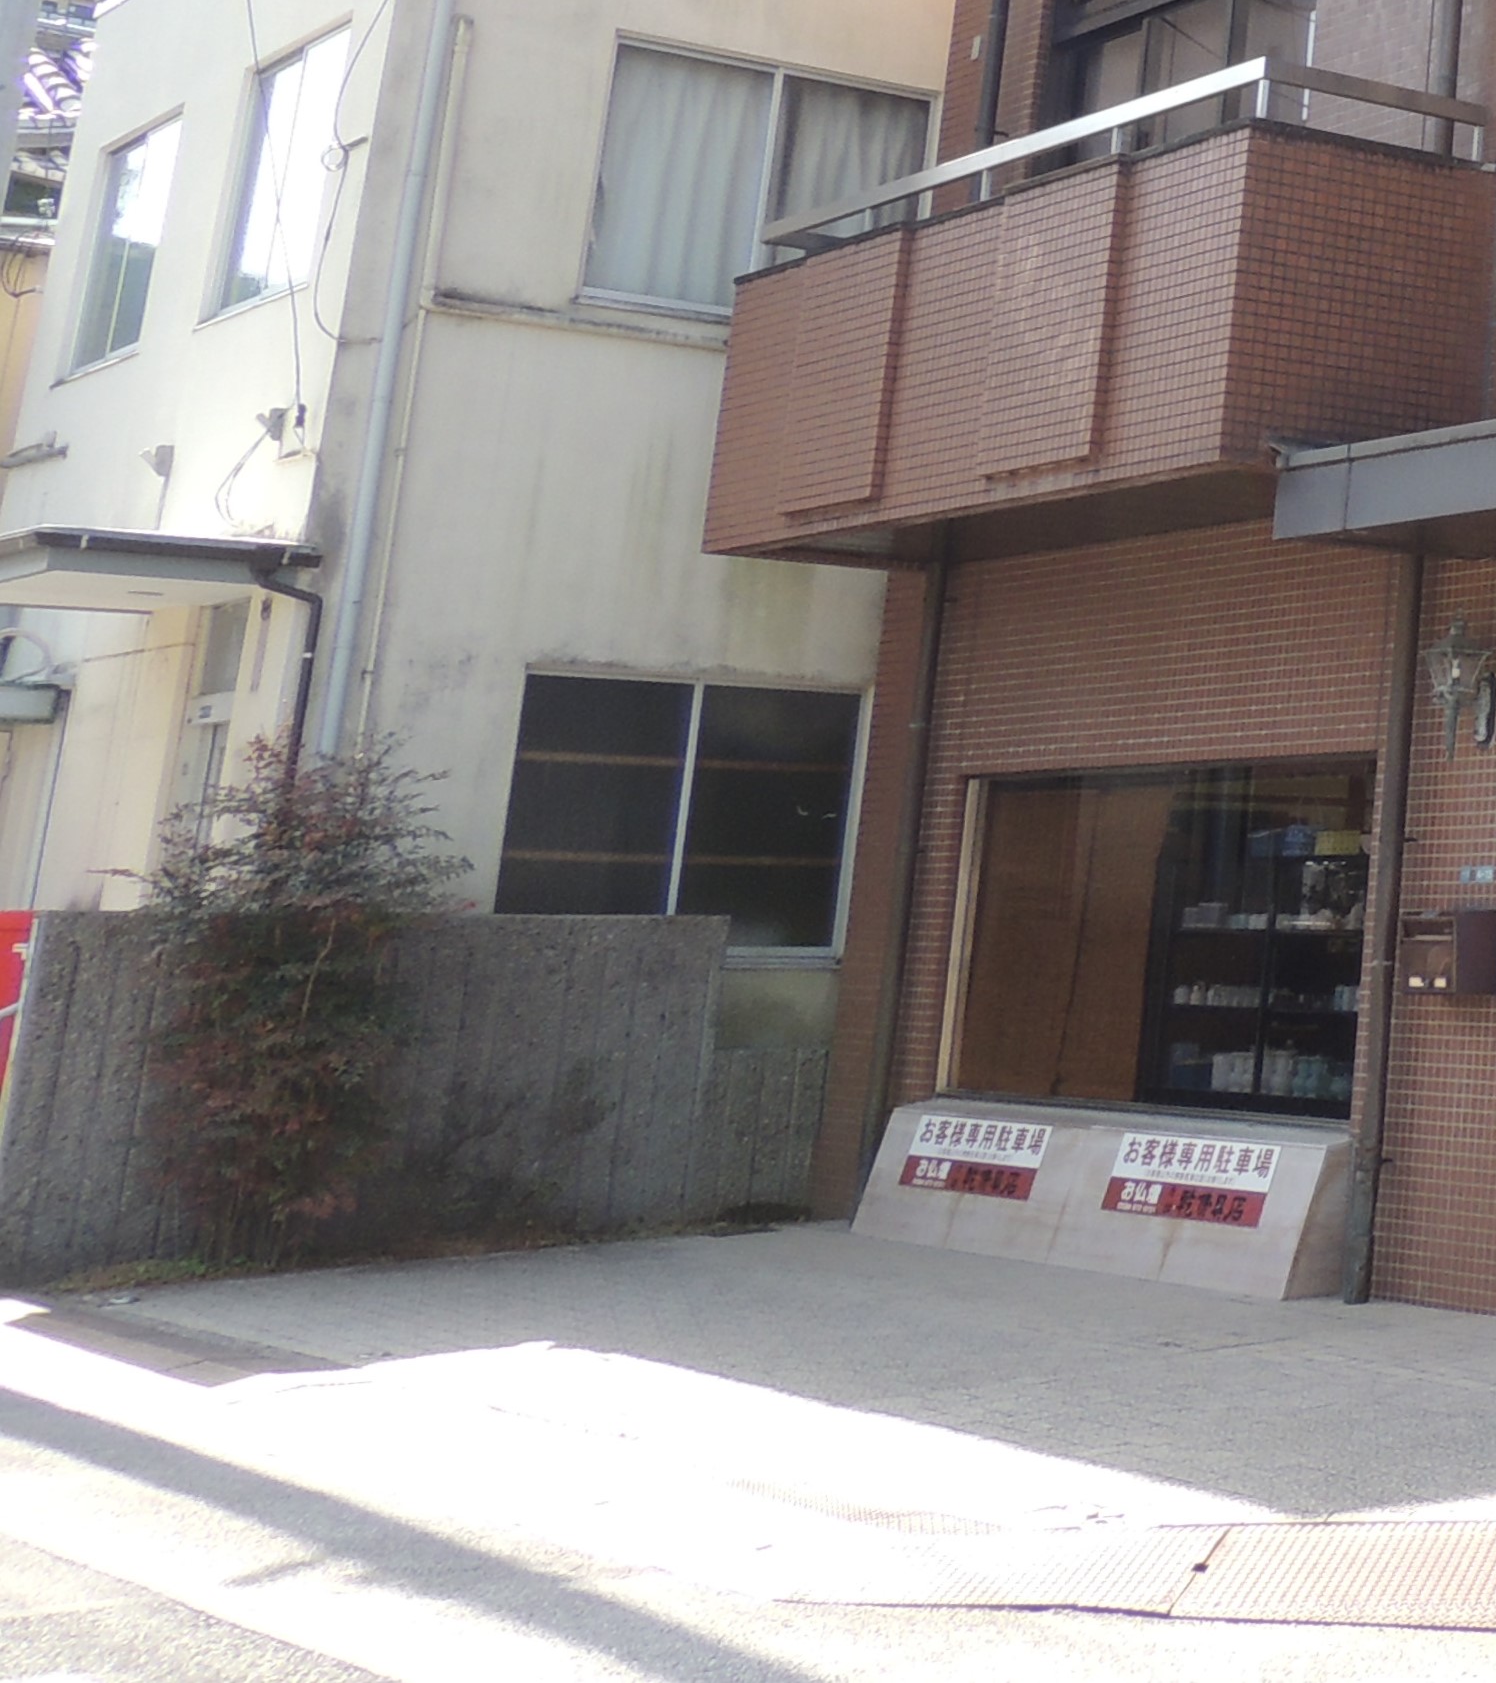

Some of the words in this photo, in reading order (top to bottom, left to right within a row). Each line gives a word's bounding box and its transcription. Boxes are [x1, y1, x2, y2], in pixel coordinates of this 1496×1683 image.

[919, 1118, 1047, 1156] お客様専用駐車場
[1122, 1137, 1275, 1179] お客様専用駐車場
